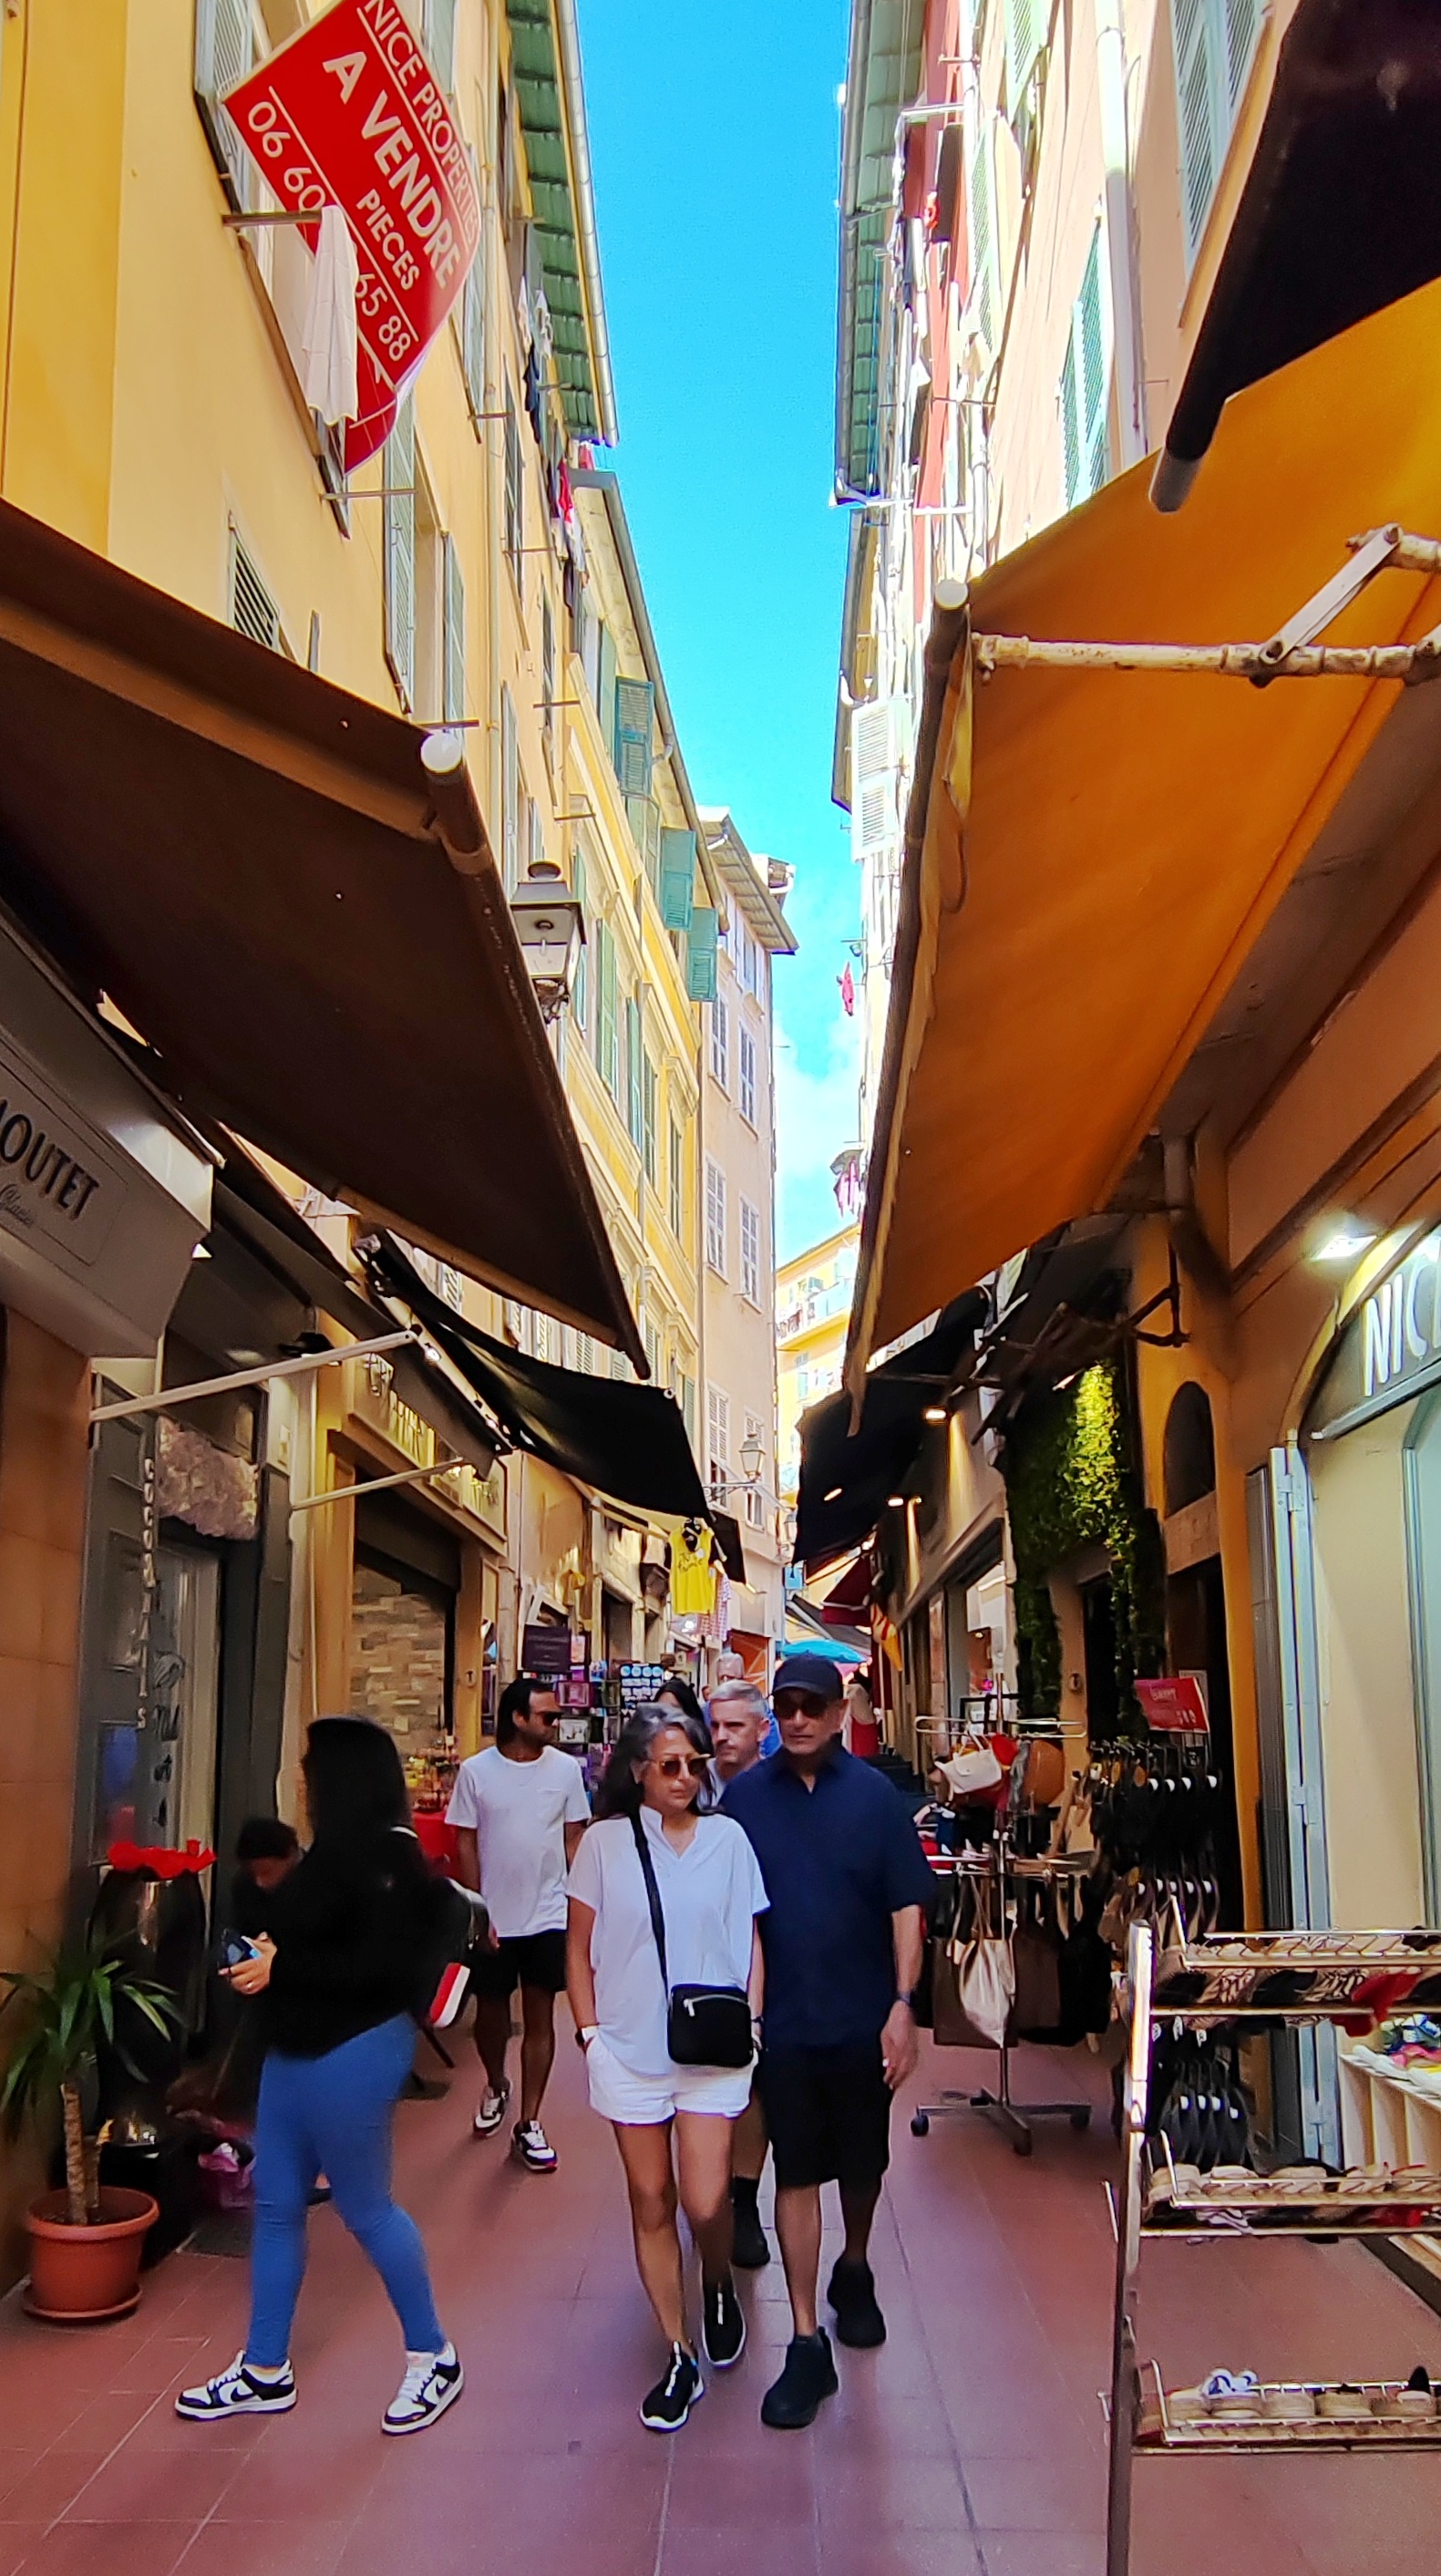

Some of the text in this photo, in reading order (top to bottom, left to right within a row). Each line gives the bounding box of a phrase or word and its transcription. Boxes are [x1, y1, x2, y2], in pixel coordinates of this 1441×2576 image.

[248, 101, 291, 158] 06
[283, 167, 326, 212] 60
[378, 315, 411, 362] 88
[322, 50, 460, 290] A VENDRE
[355, 188, 420, 290] PIECES
[364, 0, 477, 246] NICE PROPERTIES
[0, 1098, 101, 1220] OUTET
